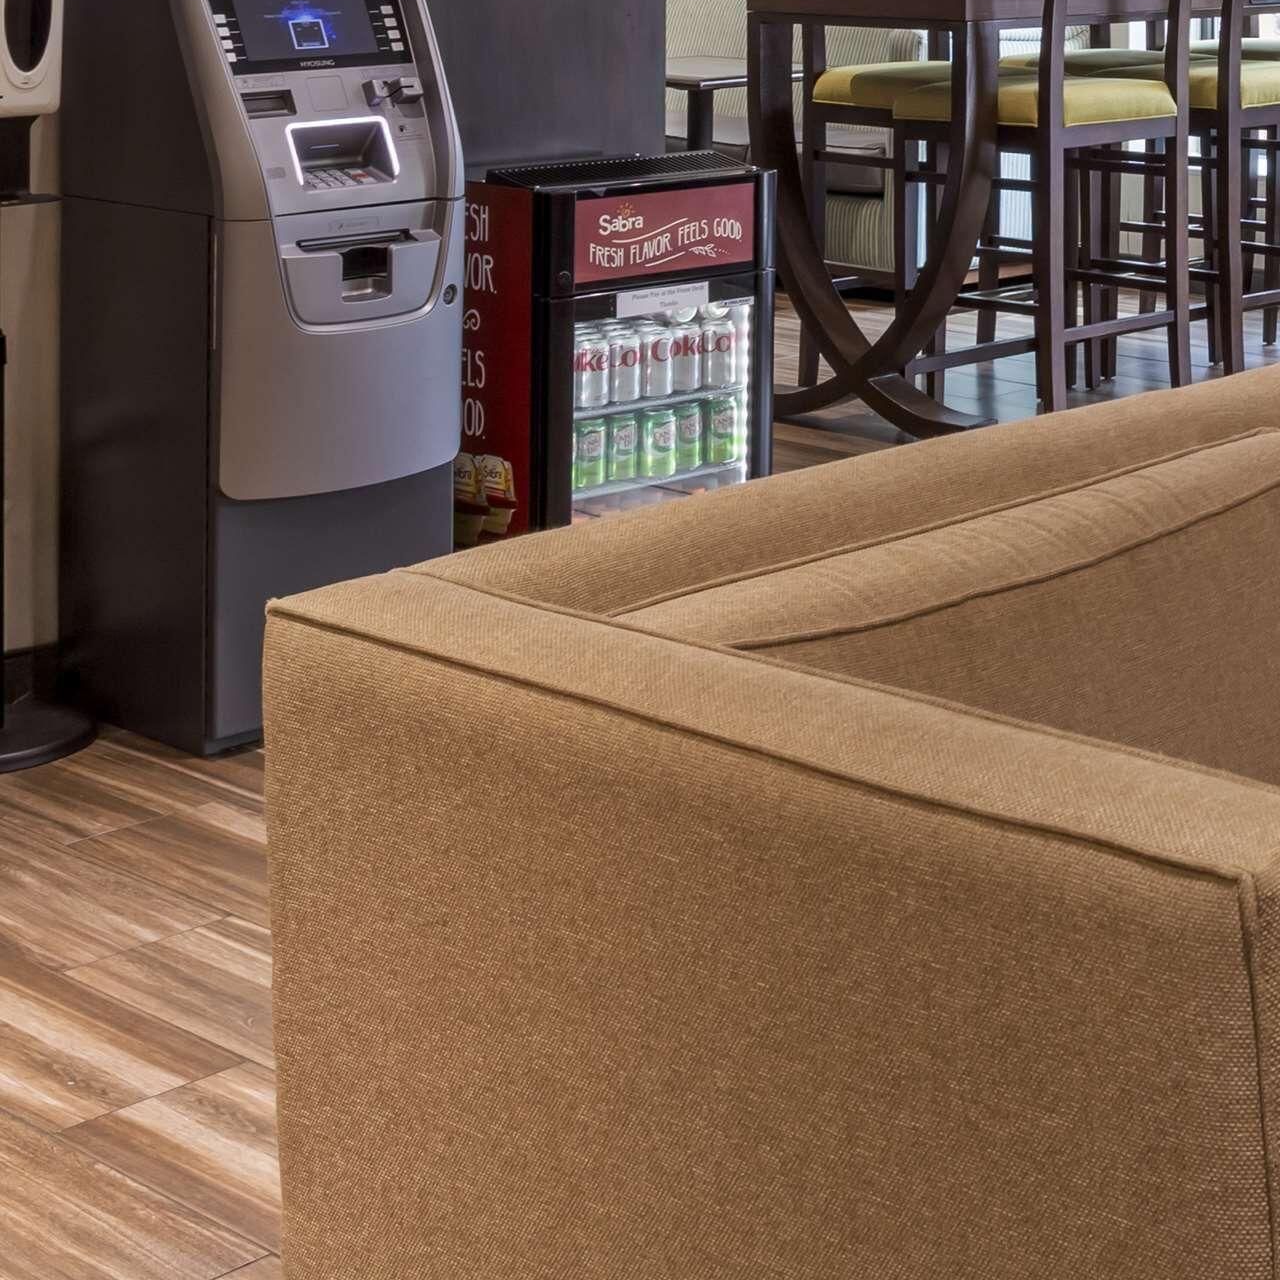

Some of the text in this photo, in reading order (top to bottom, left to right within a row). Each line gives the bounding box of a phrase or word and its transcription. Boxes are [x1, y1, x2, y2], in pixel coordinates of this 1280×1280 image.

[599, 214, 643, 236] Sabra
[589, 243, 624, 268] FRESH
[678, 219, 708, 246] FEELS
